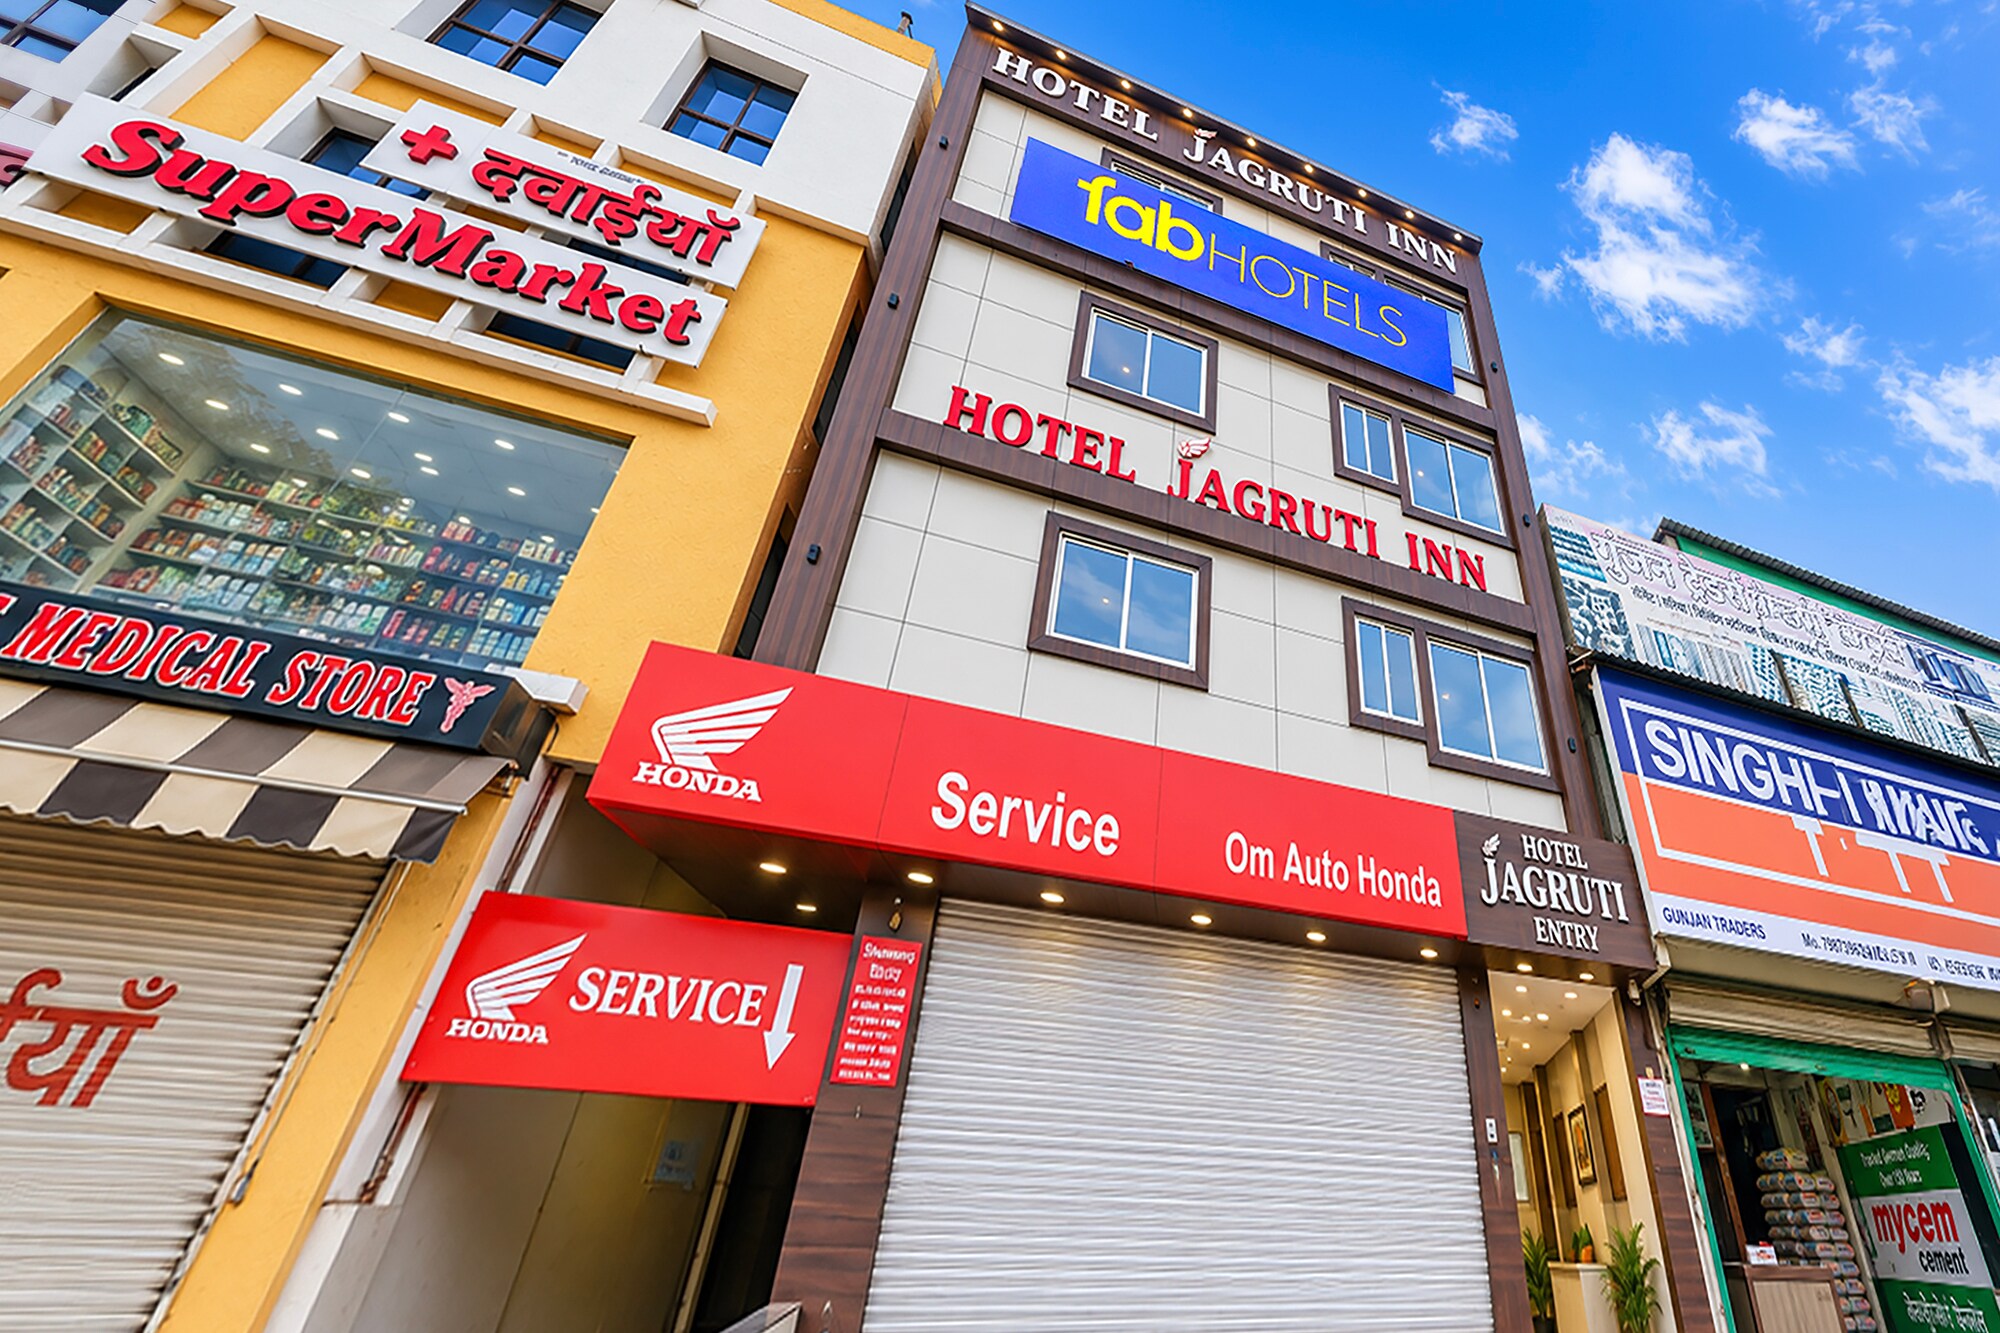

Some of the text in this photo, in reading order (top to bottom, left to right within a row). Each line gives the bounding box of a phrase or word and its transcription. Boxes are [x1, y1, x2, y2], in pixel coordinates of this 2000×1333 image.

[991, 46, 1457, 274] HOTEL JAGRUTI INN
[81, 119, 702, 346] SuperMarket
[942, 385, 1487, 592] HOTEL JAGRUTI INN
[0, 602, 435, 726] MEDICAL STORE
[632, 761, 763, 803] HONDA
[931, 770, 1121, 857] Service
[1224, 830, 1442, 908] Om Auto Honda
[1520, 833, 1589, 870] HOTEL
[1480, 857, 1630, 923] JAGRUTI
[1533, 916, 1600, 952] ENTRY
[1662, 906, 1767, 940] GUNJAN TRADERS
[568, 966, 769, 1028] SERVICE
[445, 1017, 549, 1045] HONDA
[1871, 1201, 1960, 1254] mycem
[1918, 1247, 1970, 1275] cement
